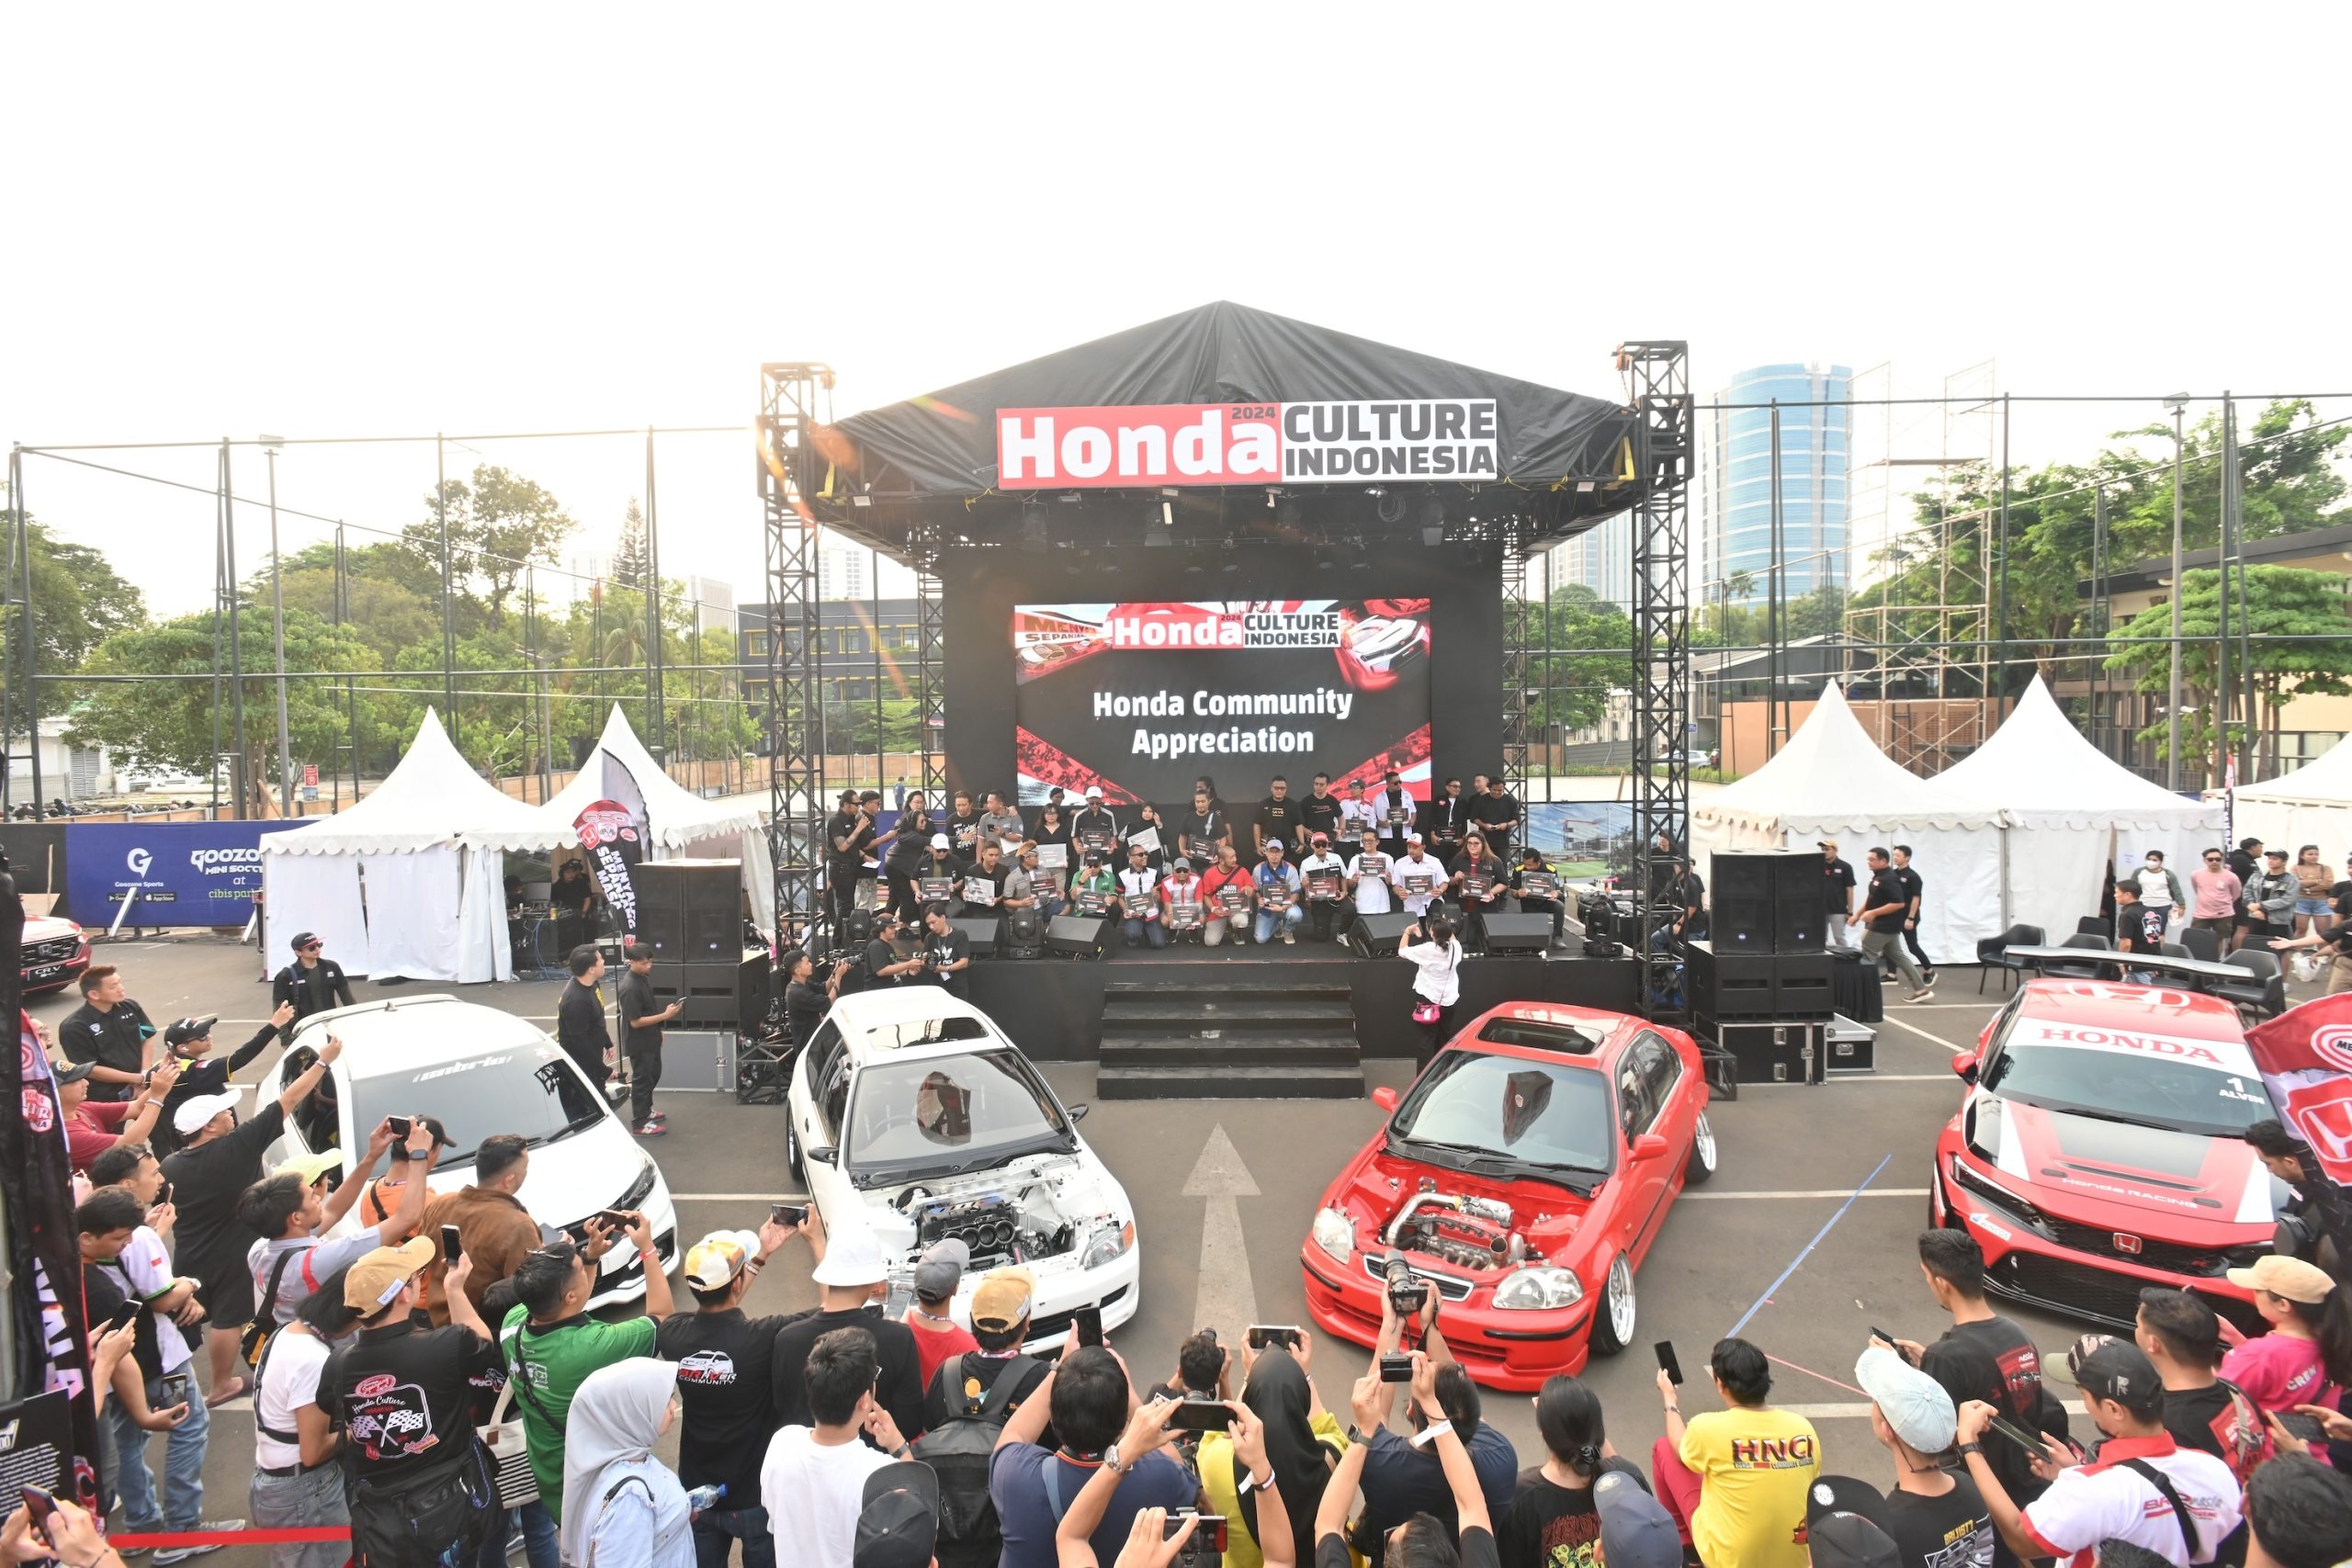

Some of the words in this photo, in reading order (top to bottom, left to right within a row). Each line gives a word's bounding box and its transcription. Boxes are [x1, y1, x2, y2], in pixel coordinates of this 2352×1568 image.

[1231, 407, 1276, 420] 2024
[1283, 403, 1496, 443] CULTURE
[1001, 410, 1278, 479] Honda
[1286, 446, 1496, 476] INDONESIA
[1114, 615, 1242, 647] Honda
[1245, 614, 1339, 631] CULTURE
[1245, 633, 1340, 646] INDONESIA
[1093, 691, 1184, 717] Honda
[1193, 688, 1352, 719] Community
[1132, 726, 1314, 759] Appreciation
[190, 849, 263, 873] GOOZO
[205, 865, 228, 875] MINI
[232, 875, 245, 885] at
[209, 888, 232, 898] cibis
[2040, 1028, 2224, 1065] HONDA
[2227, 1077, 2245, 1092] 1
[2219, 1089, 2266, 1105] ALVIN
[2062, 1177, 2124, 1194] Honda
[2127, 1189, 2198, 1209] RACING
[678, 1375, 734, 1385] COMMUNITY
[351, 1398, 375, 1415] Honda
[376, 1395, 406, 1406] Culture
[1732, 1435, 1814, 1462] HNCI
